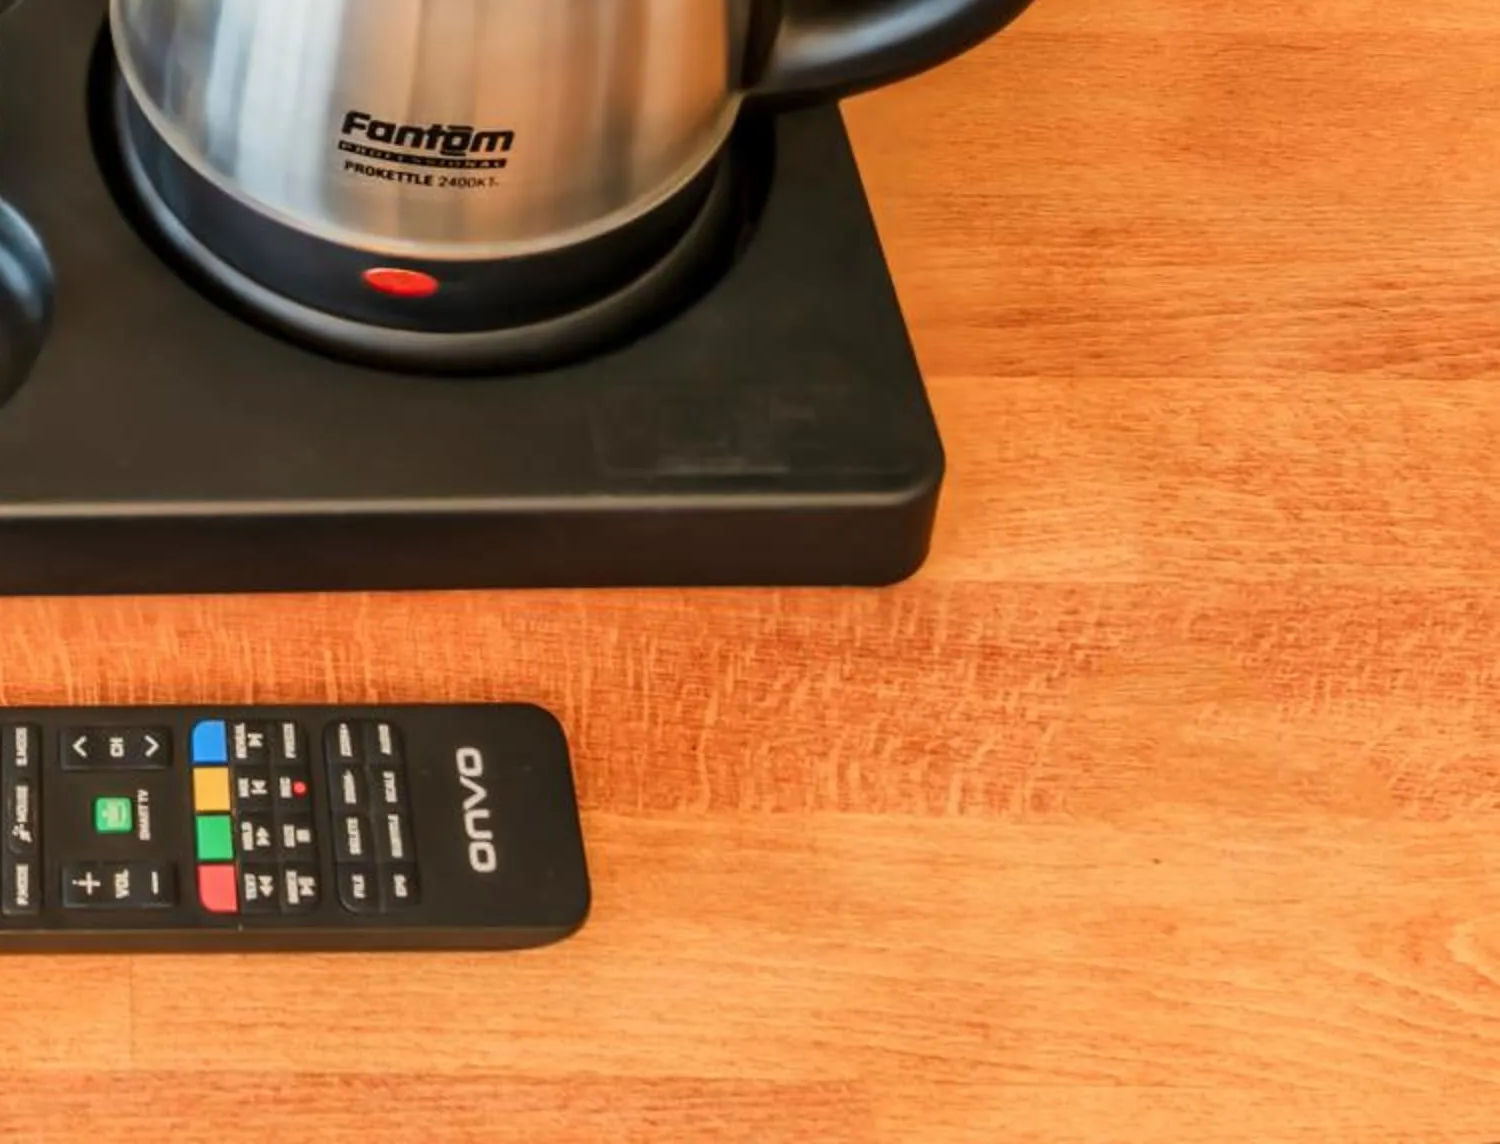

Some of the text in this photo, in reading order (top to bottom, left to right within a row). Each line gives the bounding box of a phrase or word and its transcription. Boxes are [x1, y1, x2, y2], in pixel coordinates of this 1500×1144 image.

[344, 160, 434, 186] PROKETTLE
[109, 736, 125, 758] CH
[137, 789, 149, 805] TV
[114, 868, 130, 899] VOL
